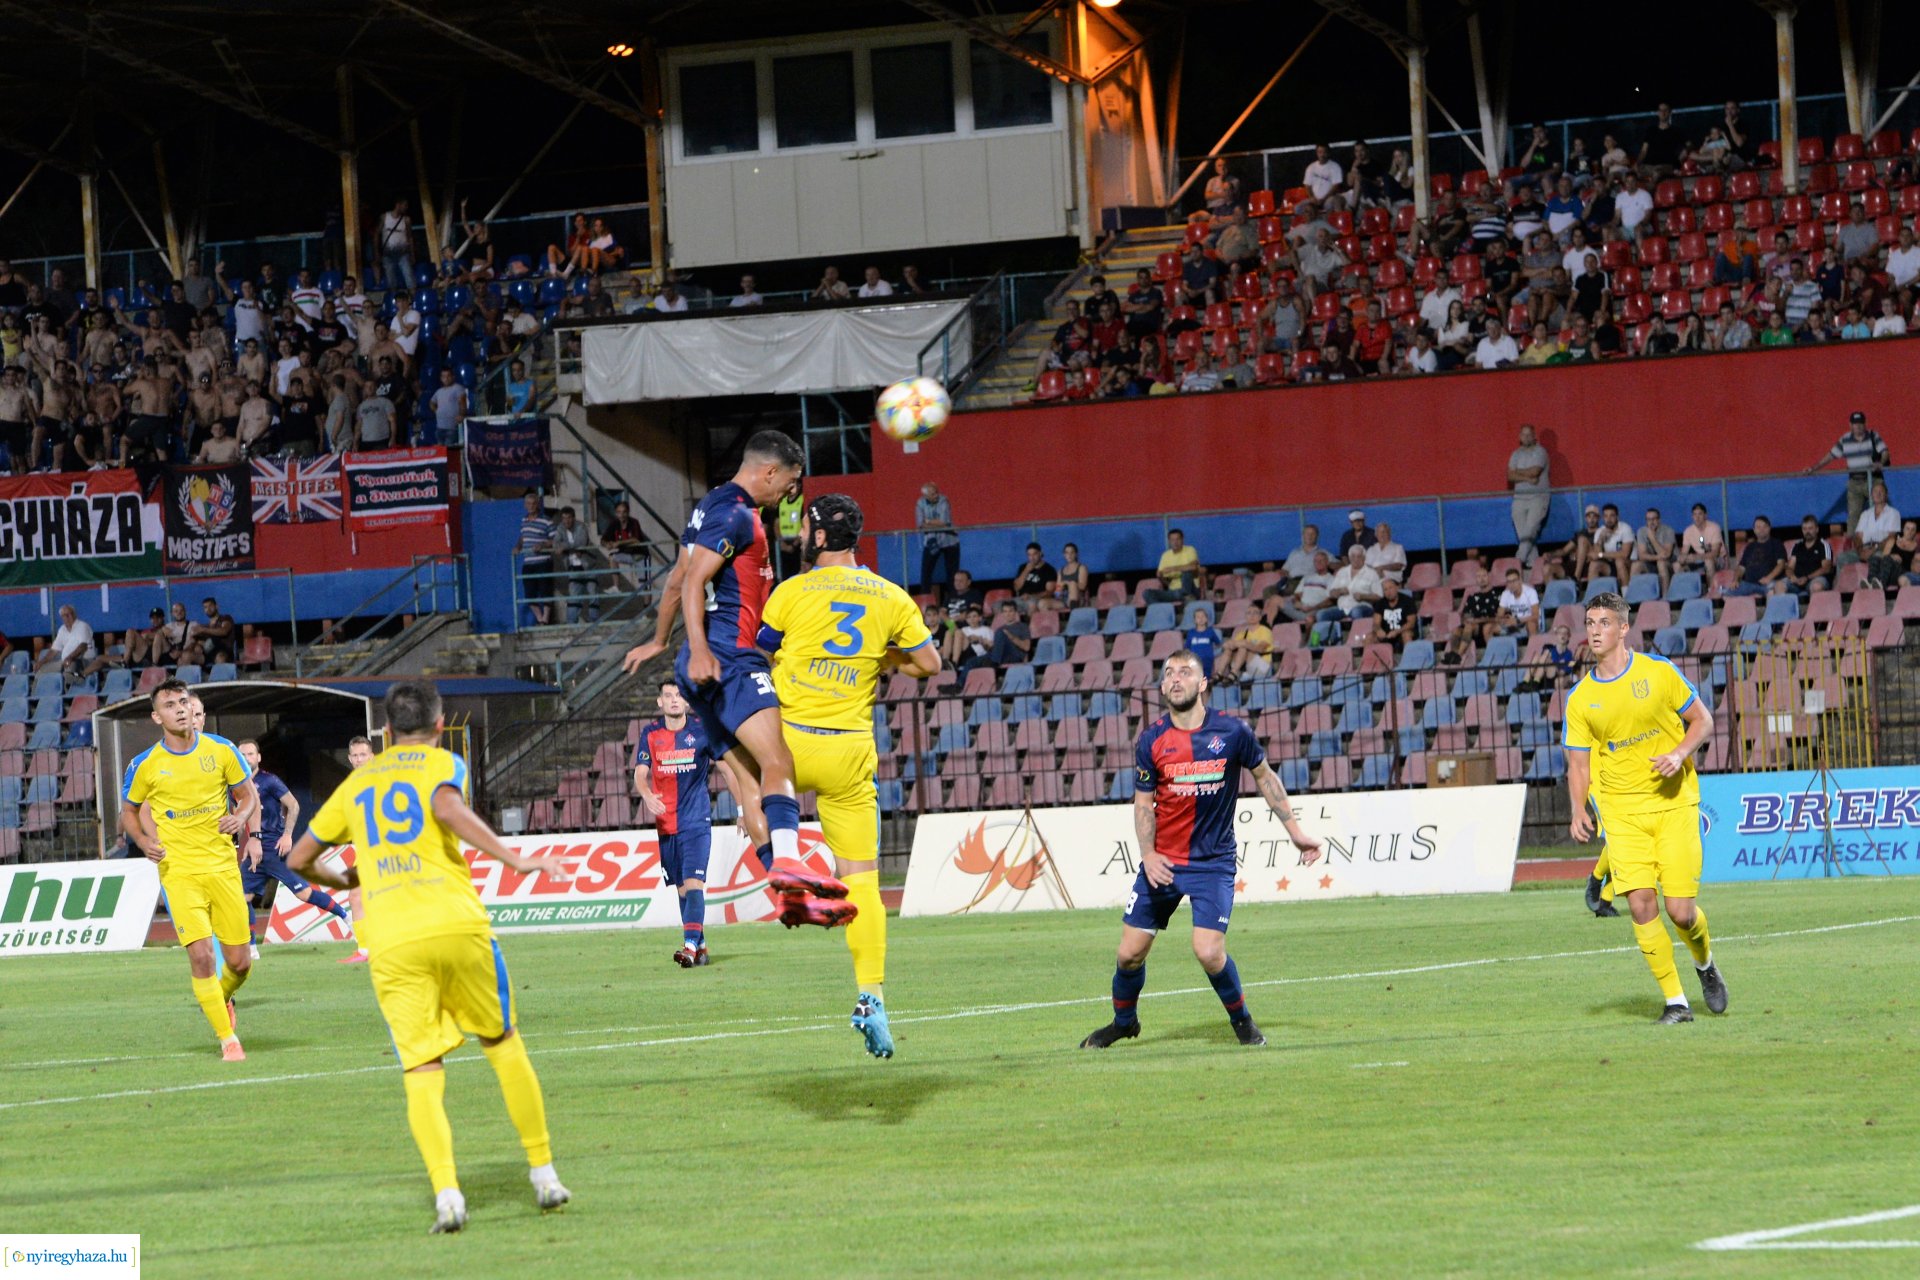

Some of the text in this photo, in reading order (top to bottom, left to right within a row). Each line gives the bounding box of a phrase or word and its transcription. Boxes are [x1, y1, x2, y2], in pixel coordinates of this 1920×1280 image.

[255, 479, 337, 497] MASTIFFS
[0, 482, 145, 562] GYHÁZA
[167, 532, 250, 560] MASTIFFS
[822, 601, 866, 657] 3
[1616, 728, 1660, 750] GREENPLAN
[354, 781, 424, 848] 19
[1239, 806, 1332, 824] OTEL
[1736, 787, 1920, 834] BREK
[462, 841, 661, 897] EVESZ
[1733, 839, 1909, 867] ALKATRÉSZEK
[0, 871, 126, 924] hu
[498, 908, 523, 922] ON
[525, 906, 555, 921] THE
[555, 904, 606, 920] RIGHT
[606, 902, 645, 917] WAY
